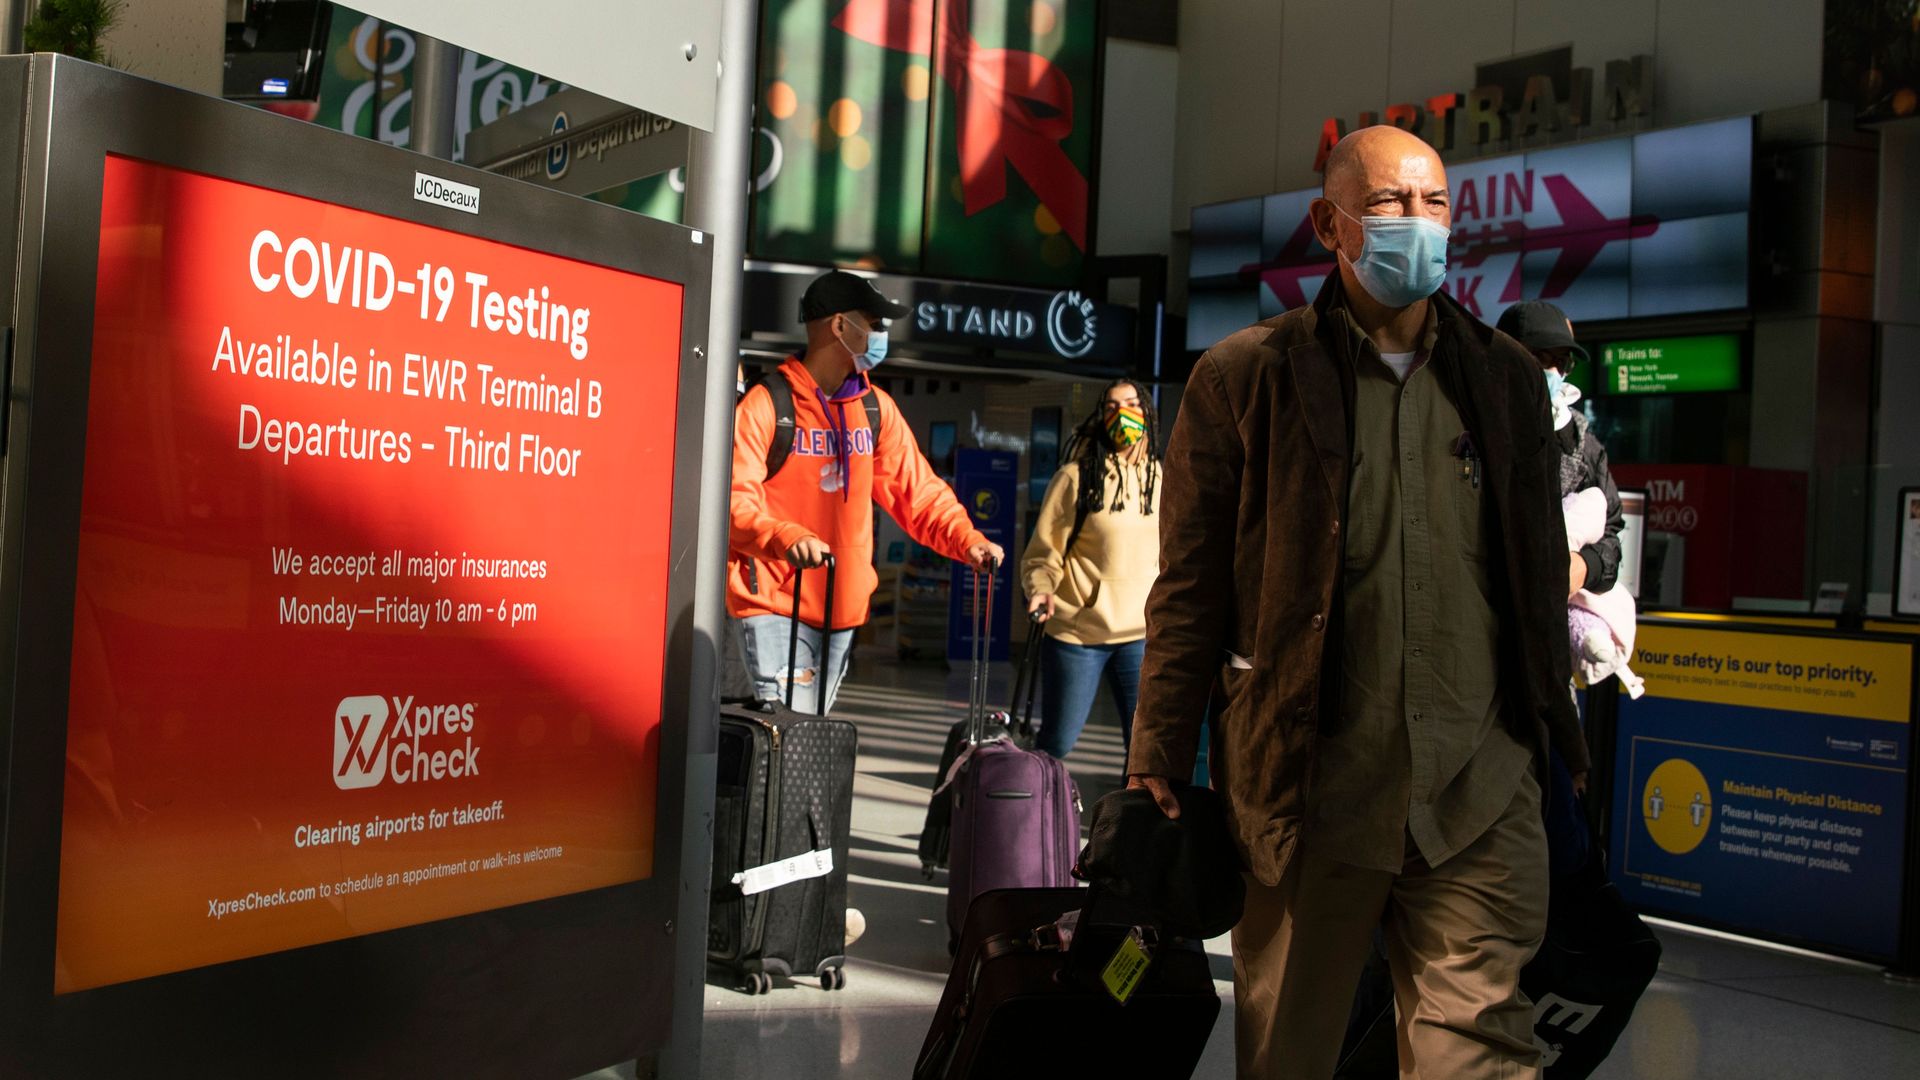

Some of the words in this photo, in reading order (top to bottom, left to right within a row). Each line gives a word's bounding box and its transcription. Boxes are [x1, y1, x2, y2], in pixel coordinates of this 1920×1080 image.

[416, 178, 477, 208] JCDecaux
[1453, 169, 1533, 222] AIN
[249, 229, 455, 322] COVID-19
[465, 271, 590, 361] Testing
[917, 301, 1037, 339] STAND
[212, 326, 357, 389] Available
[367, 348, 392, 393] in
[402, 352, 468, 402] EWR
[477, 363, 580, 417] Terminal
[587, 380, 602, 418] B
[1617, 348, 1647, 360] Trains
[238, 403, 412, 465] Departures
[444, 426, 510, 472] Third
[519, 434, 581, 478] Floor
[789, 427, 873, 456] LEMSON
[1645, 479, 1684, 501] ATM
[272, 546, 302, 576] We
[309, 551, 376, 583] accept
[382, 549, 402, 577] all
[407, 551, 457, 584] major
[461, 552, 547, 578] insurances
[435, 599, 453, 622] 10
[457, 603, 482, 622] am
[497, 599, 507, 621] 6
[511, 601, 538, 627] pm
[1637, 648, 1669, 664] Your
[1673, 651, 1723, 673] safety
[1726, 654, 1741, 671] is
[1744, 659, 1772, 674] our
[1775, 659, 1804, 680] top
[1807, 662, 1877, 687] priority.
[390, 695, 475, 743] Xpres
[390, 737, 480, 784] Check
[1723, 779, 1773, 800] Maintain
[1775, 786, 1825, 808] Physical
[1826, 794, 1883, 816] Distance
[294, 820, 361, 848] Clearing
[365, 812, 425, 841] airports
[429, 808, 449, 828] for
[452, 800, 505, 826] takeoff.
[1720, 822, 1761, 839] between
[1761, 829, 1783, 844] your
[1784, 834, 1811, 851] party
[1812, 838, 1832, 851] and
[1833, 841, 1861, 856] other
[1721, 803, 1753, 820] Please
[1753, 809, 1777, 826] keep
[1778, 813, 1819, 832] physical
[1819, 819, 1863, 837] distance
[1719, 840, 1760, 857] travelers
[1761, 847, 1807, 865] whenever
[1807, 856, 1852, 873] possible.
[207, 883, 316, 919] XpresCheck.com
[319, 882, 332, 898] to
[334, 873, 384, 895] schedule
[386, 871, 400, 886] an
[402, 859, 467, 886] appointment
[469, 857, 480, 872] or
[482, 850, 521, 870] walk-ins
[523, 844, 563, 863] welcome
